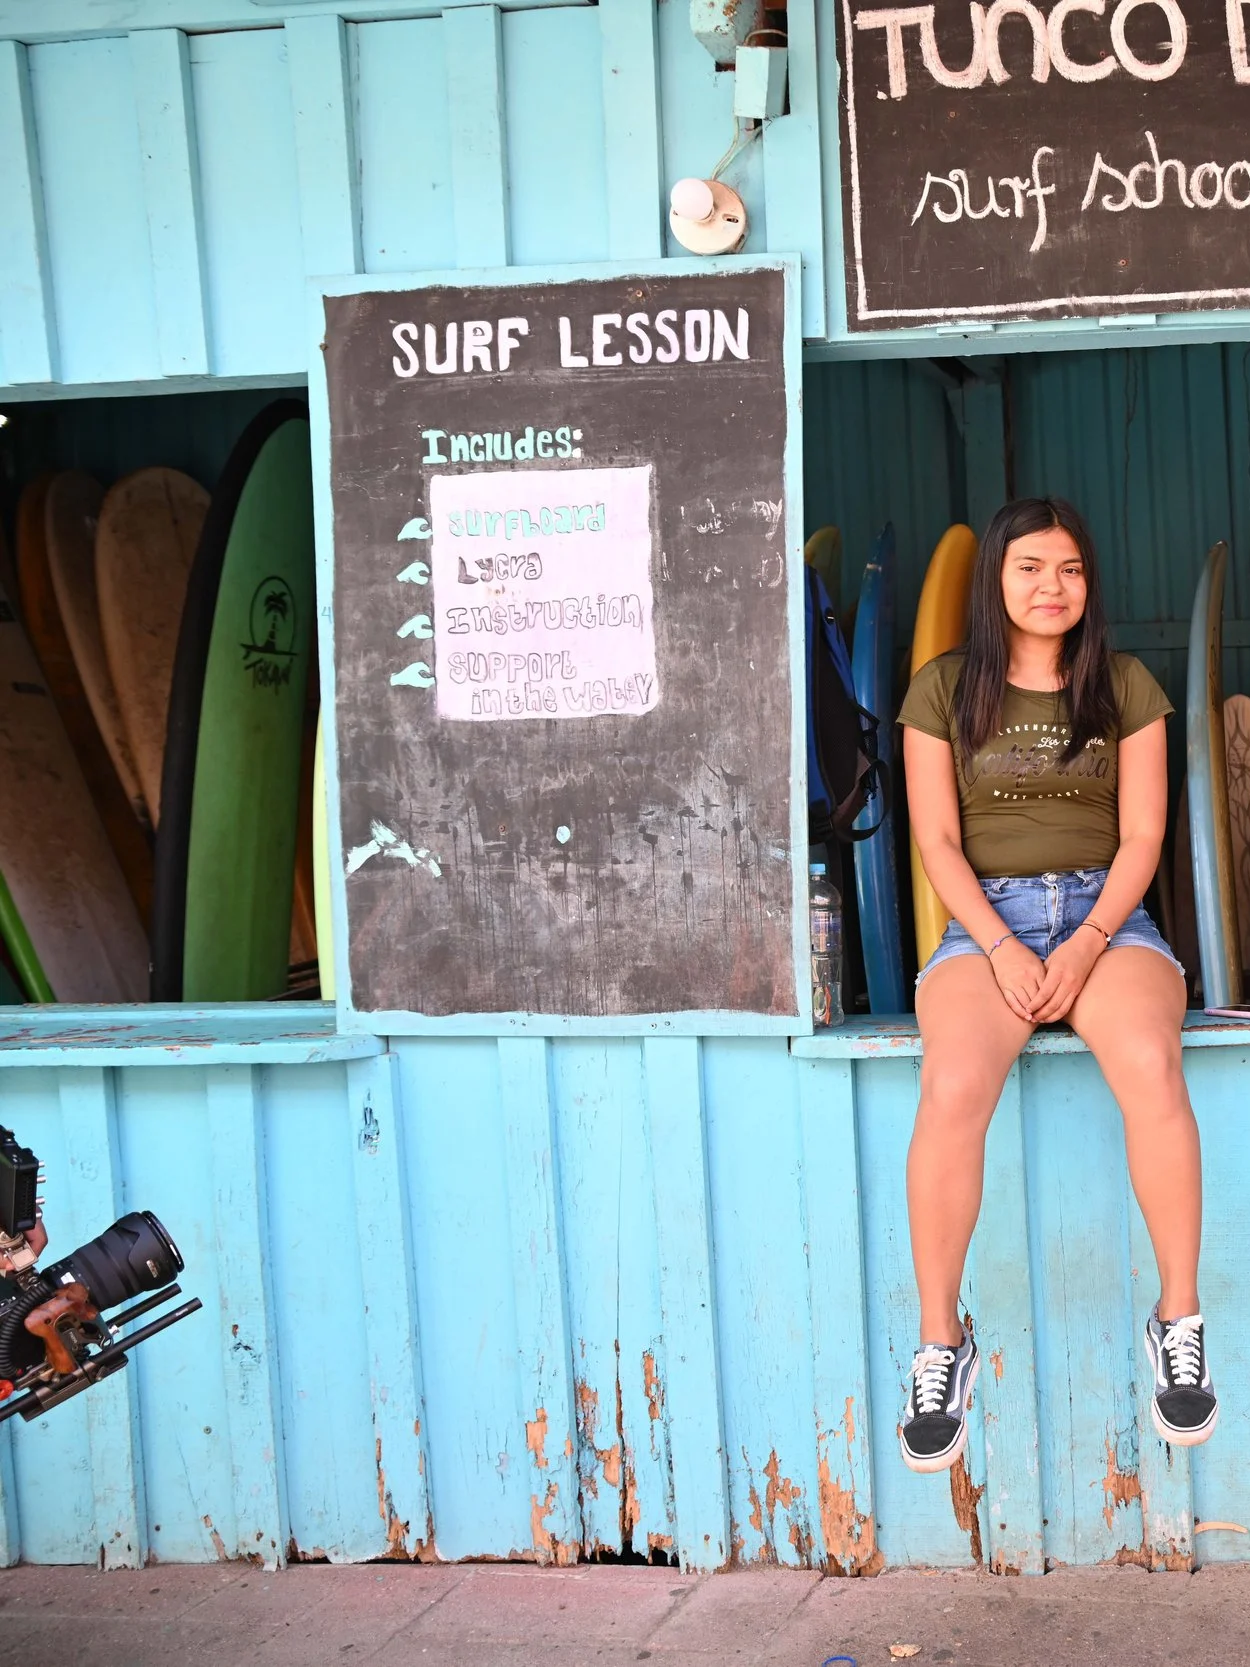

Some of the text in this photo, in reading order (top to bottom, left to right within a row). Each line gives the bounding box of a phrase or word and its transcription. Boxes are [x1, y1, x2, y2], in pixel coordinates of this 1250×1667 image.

[911, 146, 1055, 253] surf
[392, 307, 750, 377] SURF LESSON
[421, 426, 582, 464] Includes:
[457, 552, 543, 584] Lycra
[446, 593, 643, 635] Instruction
[471, 687, 503, 714] in
[505, 682, 558, 712] the
[997, 724, 1073, 737] LEGENDAR
[1037, 736, 1060, 749] Los
[993, 789, 1080, 800] WEST COAST
